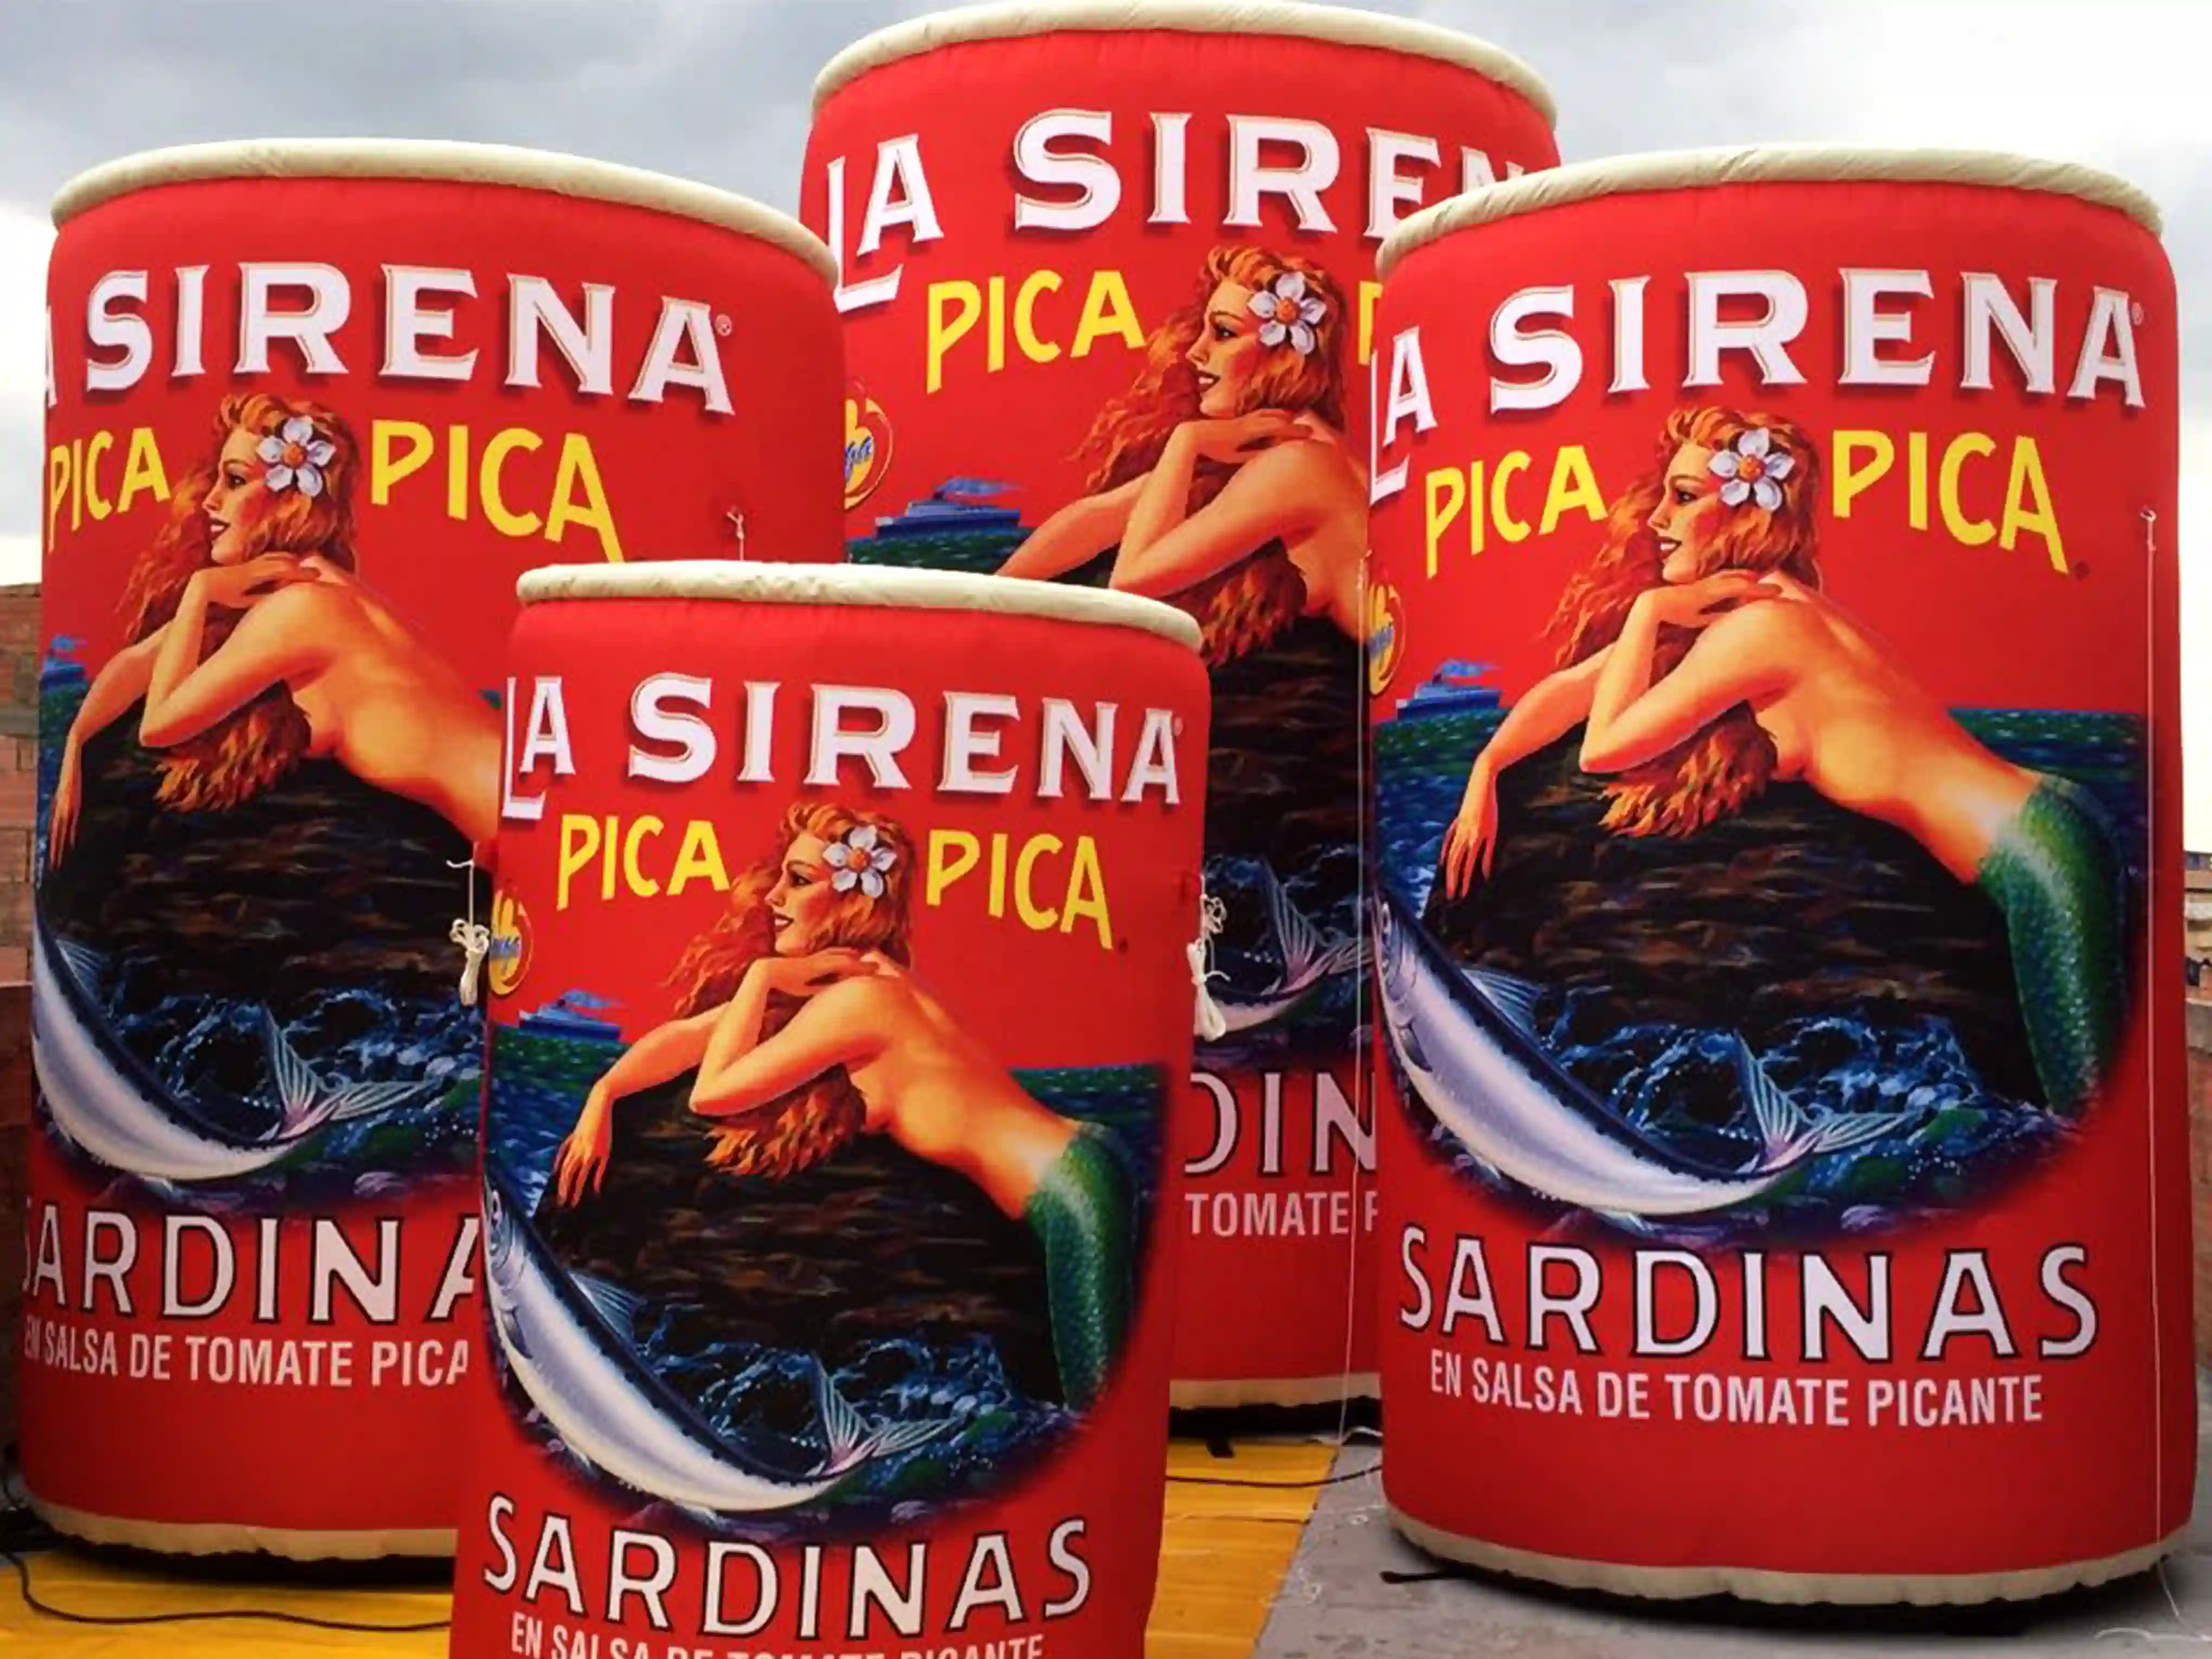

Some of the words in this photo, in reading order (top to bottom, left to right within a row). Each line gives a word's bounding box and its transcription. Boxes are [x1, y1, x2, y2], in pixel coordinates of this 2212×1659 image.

[827, 133, 944, 313] LA
[88, 263, 734, 414] SIRENA
[928, 271, 1145, 393] PICA
[1369, 326, 1438, 506] LA
[1490, 269, 2144, 412] SIRENA
[49, 428, 171, 553] PICA
[372, 420, 624, 563] PICA
[1426, 446, 1608, 577] PICA
[1833, 430, 2067, 572] PICA
[503, 677, 575, 819] LA
[629, 672, 1179, 803] SIRENA
[558, 815, 729, 909] PICA
[927, 830, 1111, 948] PICA
[23, 1196, 480, 1320] ARDINA
[1185, 1192, 1349, 1236] TOMATE
[46, 1322, 117, 1375] SALSA
[131, 1334, 171, 1379] DE
[185, 1336, 352, 1386] TOMATE
[1400, 1226, 2096, 1359] SARDINAS
[1432, 1350, 1460, 1397] EN
[1473, 1358, 1582, 1414] SALSA
[1598, 1372, 1649, 1418] DE
[1665, 1374, 1848, 1425] TOMATE
[1868, 1376, 2041, 1426] PICANTE
[484, 1495, 1089, 1637] SARDINAS
[512, 1612, 542, 1659] EN
